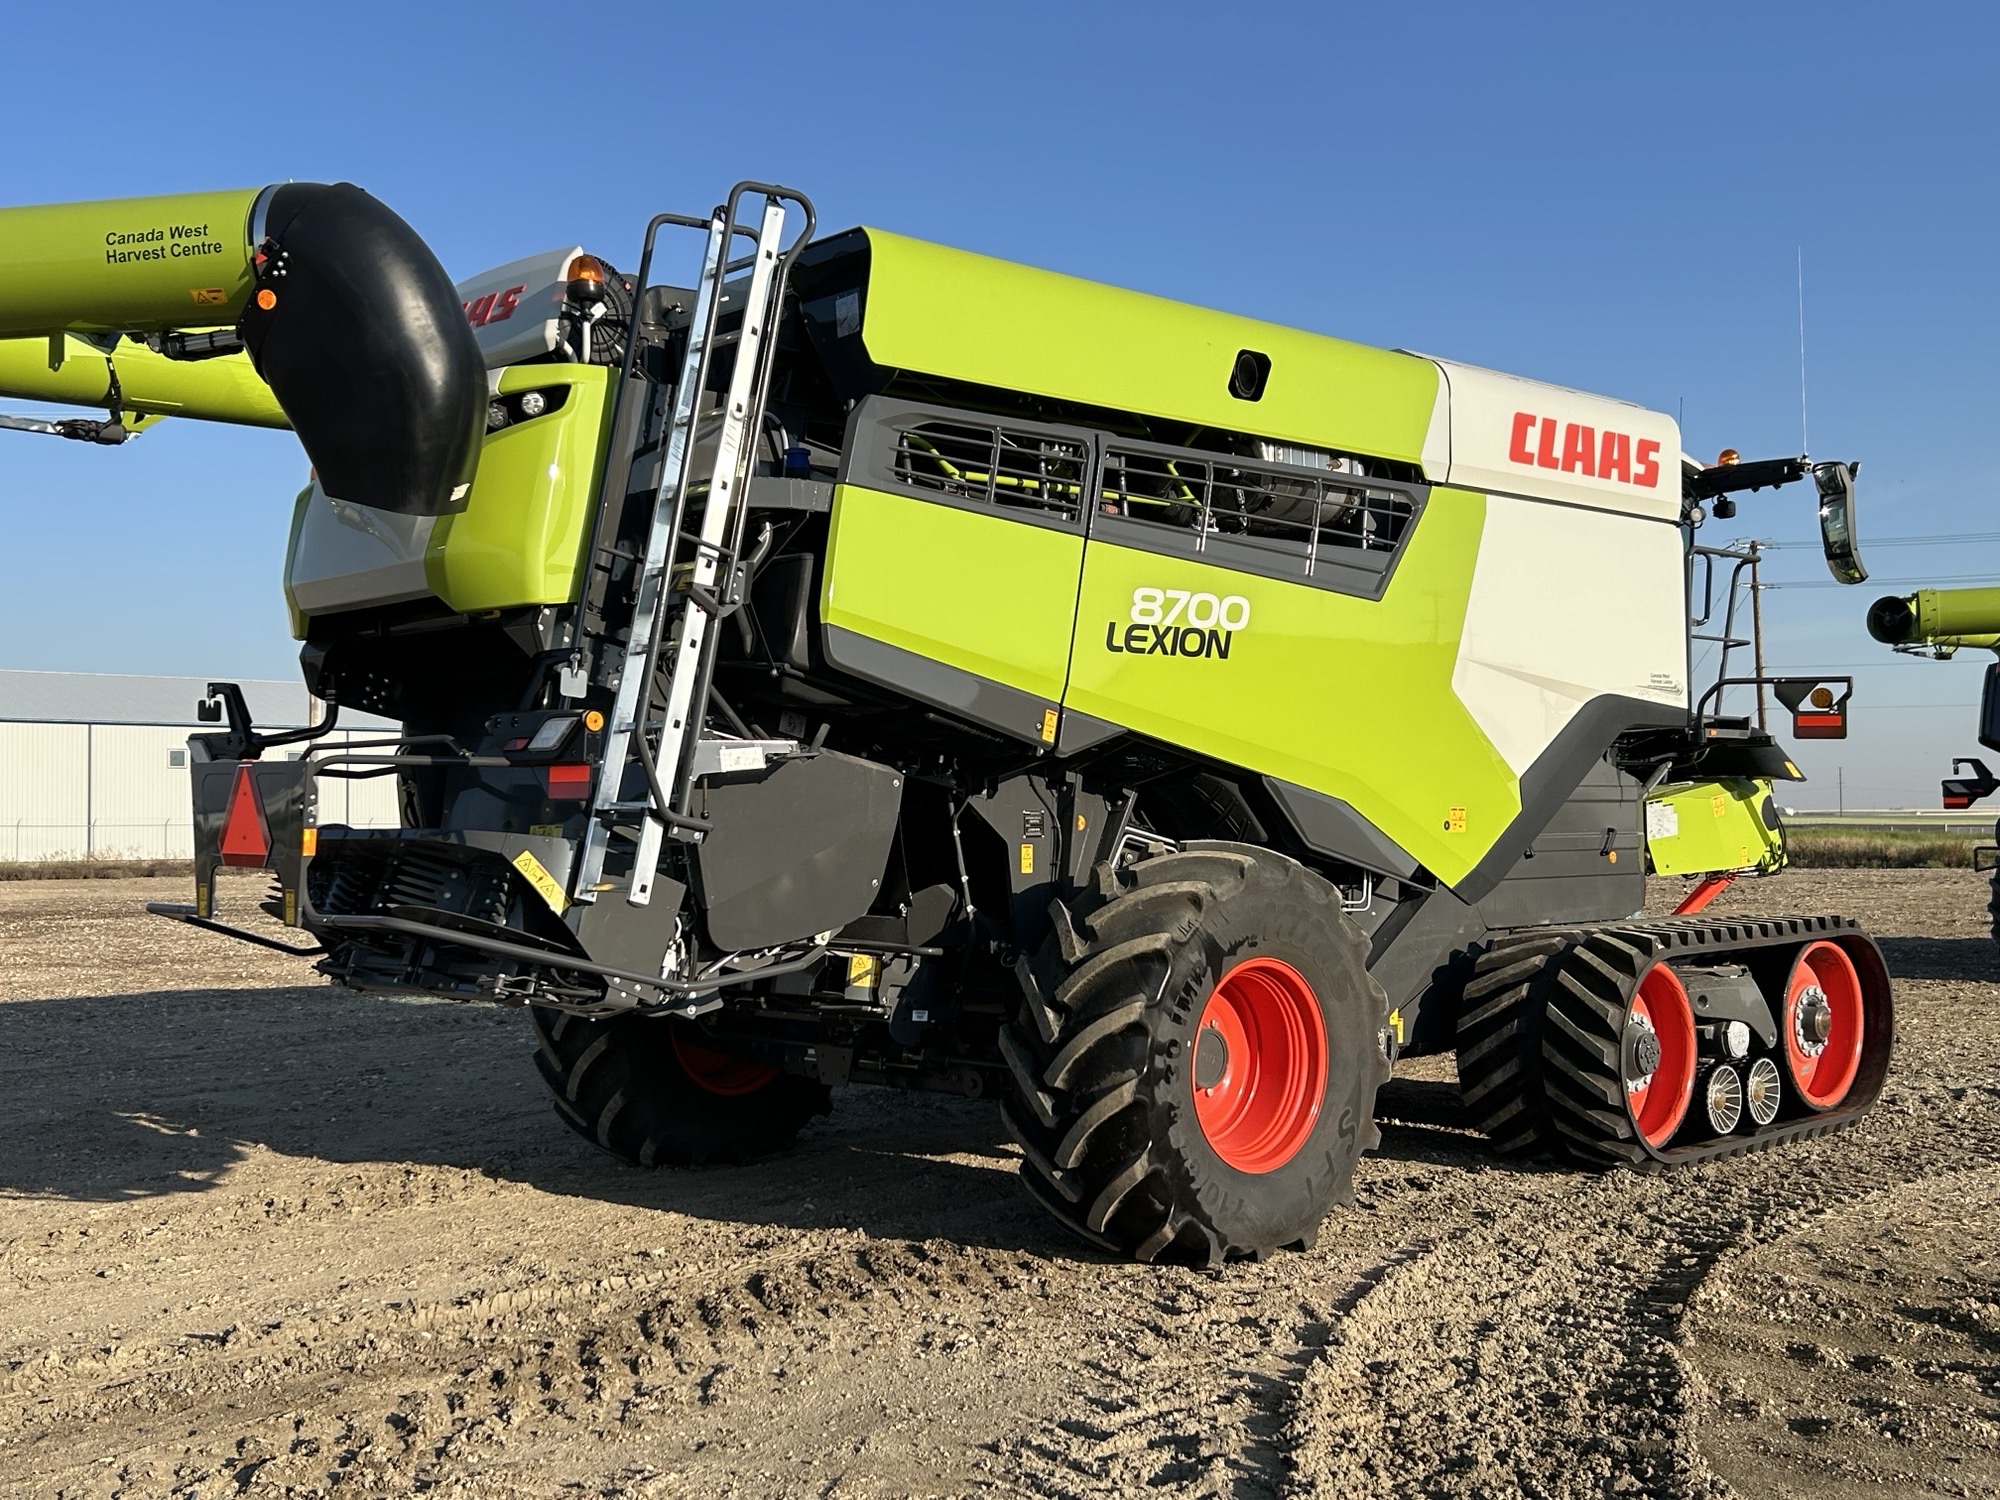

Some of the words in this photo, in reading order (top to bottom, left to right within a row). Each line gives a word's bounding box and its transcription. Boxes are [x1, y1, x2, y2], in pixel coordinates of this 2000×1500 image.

[105, 228, 164, 246] Canada
[169, 224, 209, 239] West
[106, 245, 166, 264] Harvest
[170, 241, 223, 257] Centre
[463, 284, 527, 327] AS
[1509, 411, 1661, 489] CLAAS
[1130, 587, 1251, 631] 8700
[1106, 621, 1232, 659] LEXION
